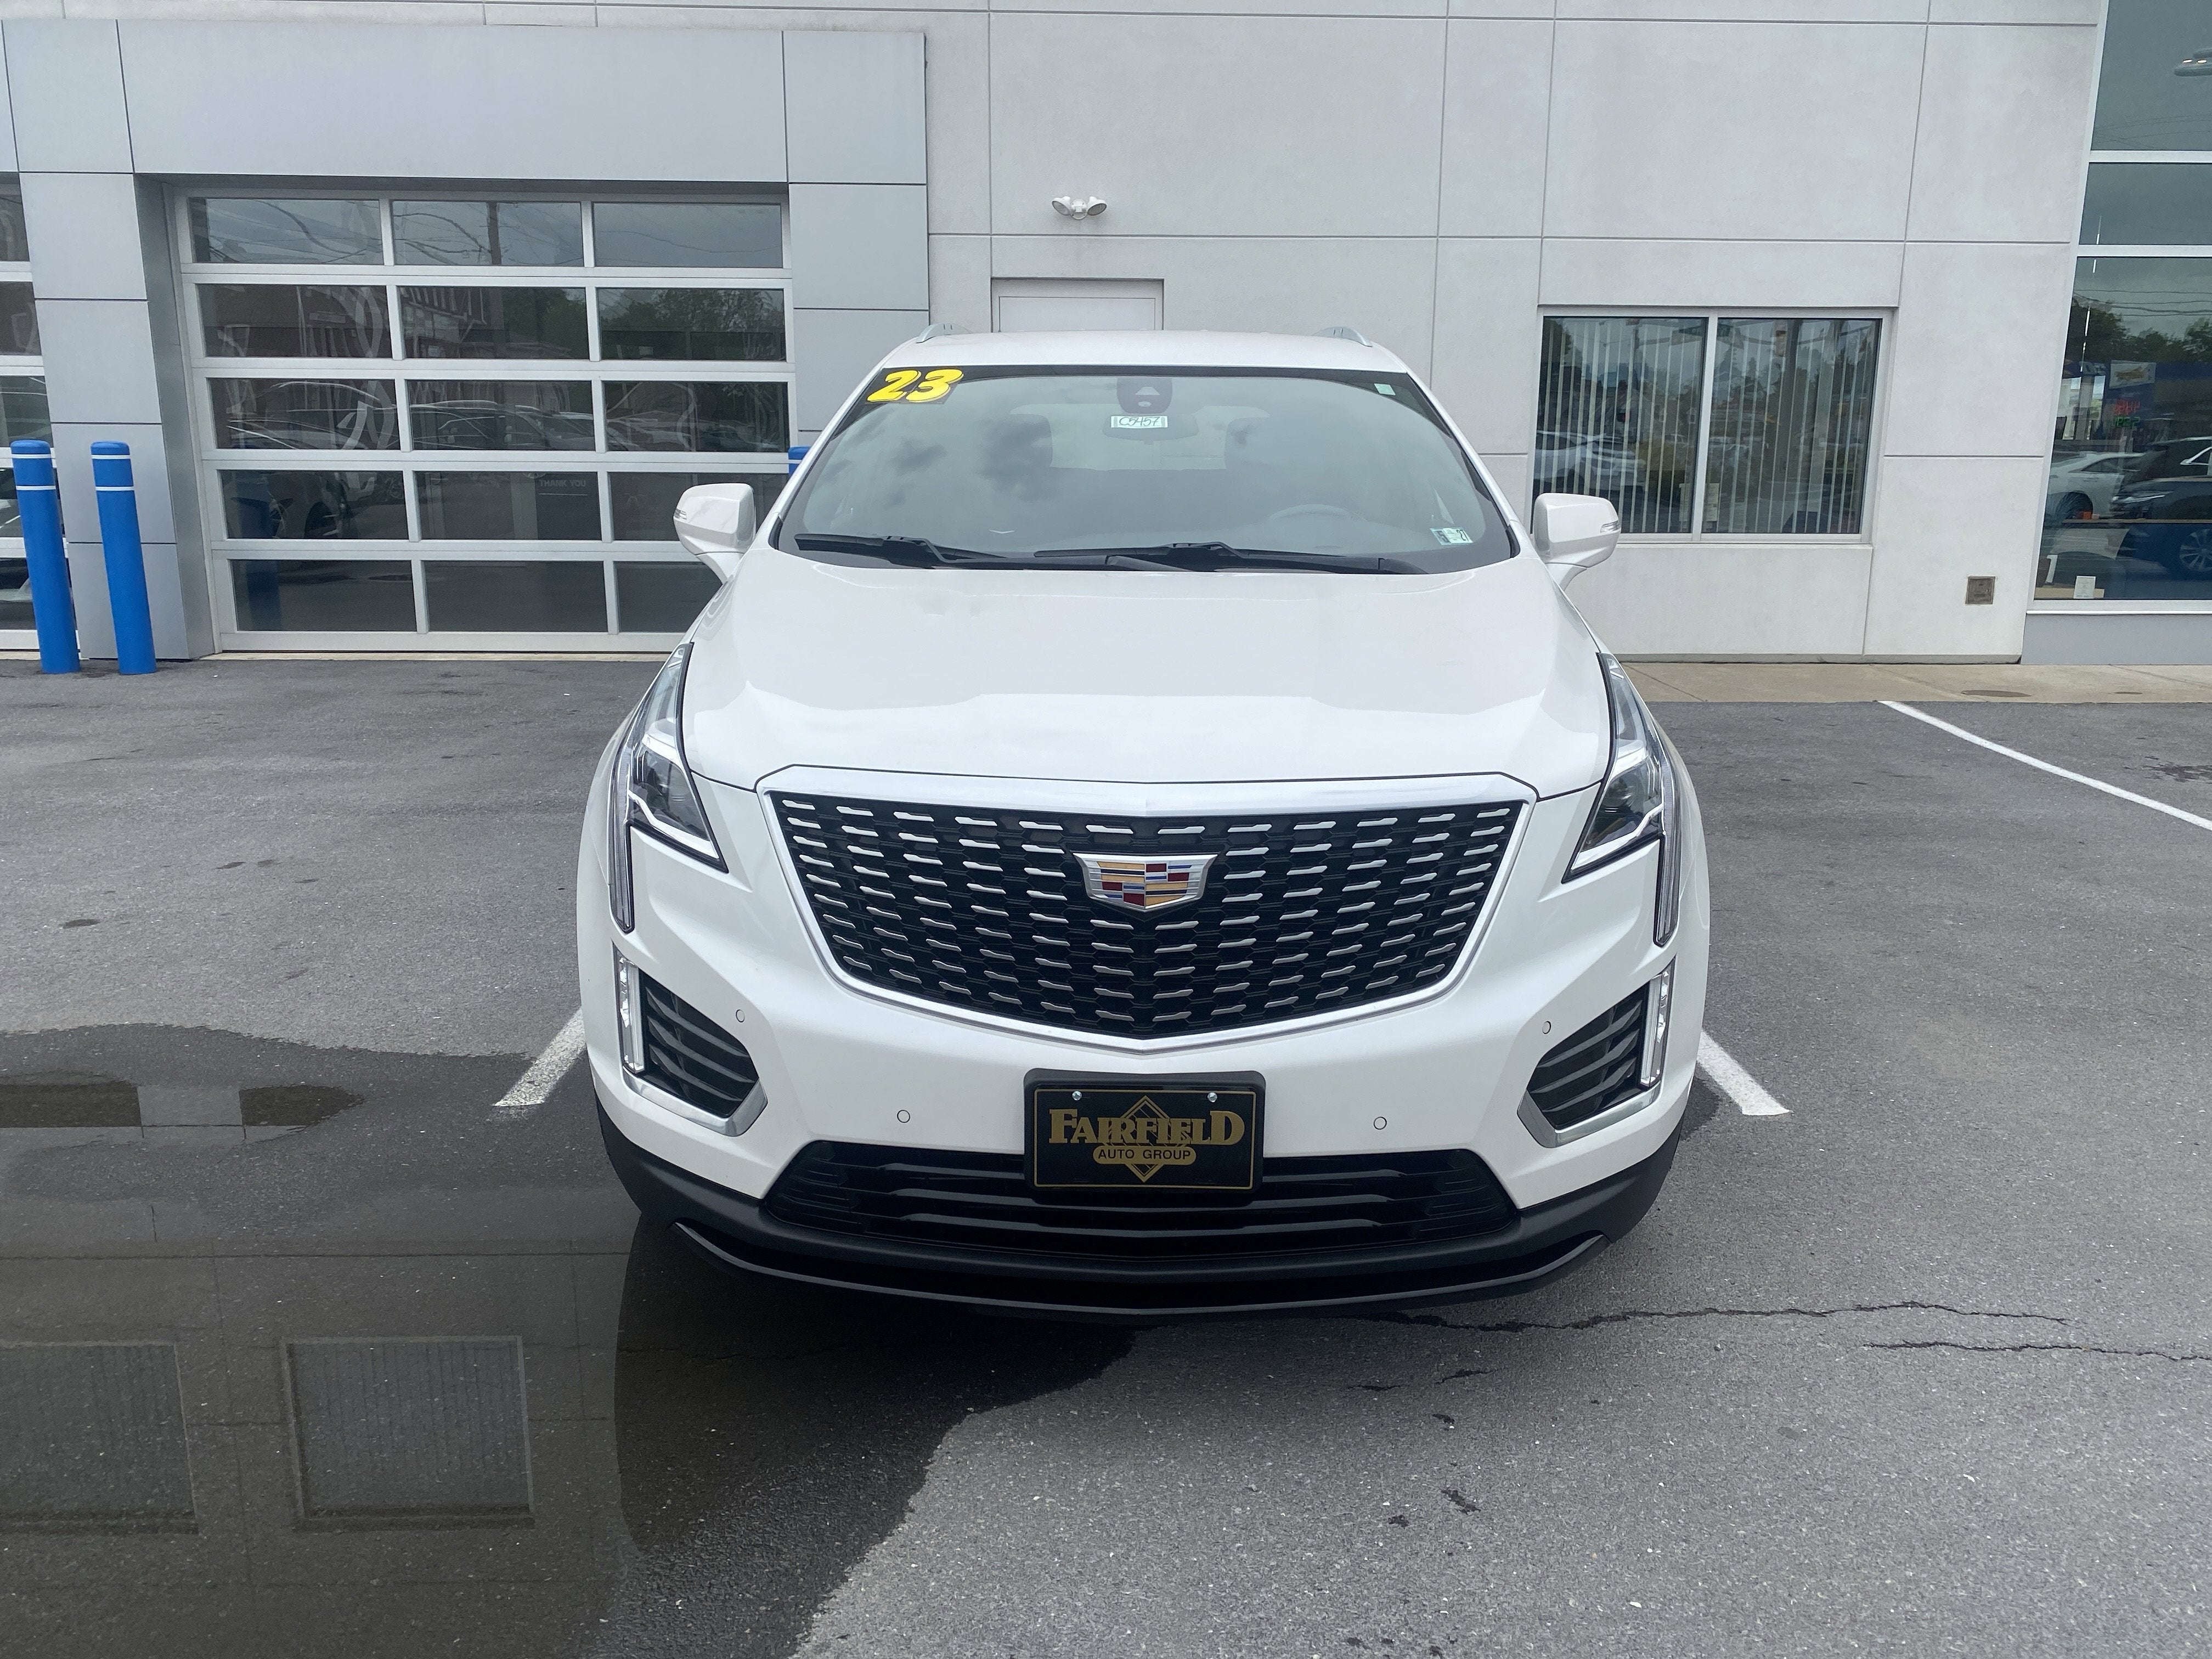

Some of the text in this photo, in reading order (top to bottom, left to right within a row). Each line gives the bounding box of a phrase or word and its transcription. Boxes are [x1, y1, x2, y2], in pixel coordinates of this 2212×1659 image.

[867, 368, 964, 403] 23
[1119, 416, 1160, 426] C5457
[1048, 1109, 1245, 1146] FAIRFIELD
[1098, 1149, 1191, 1160] AUTO GROUP
